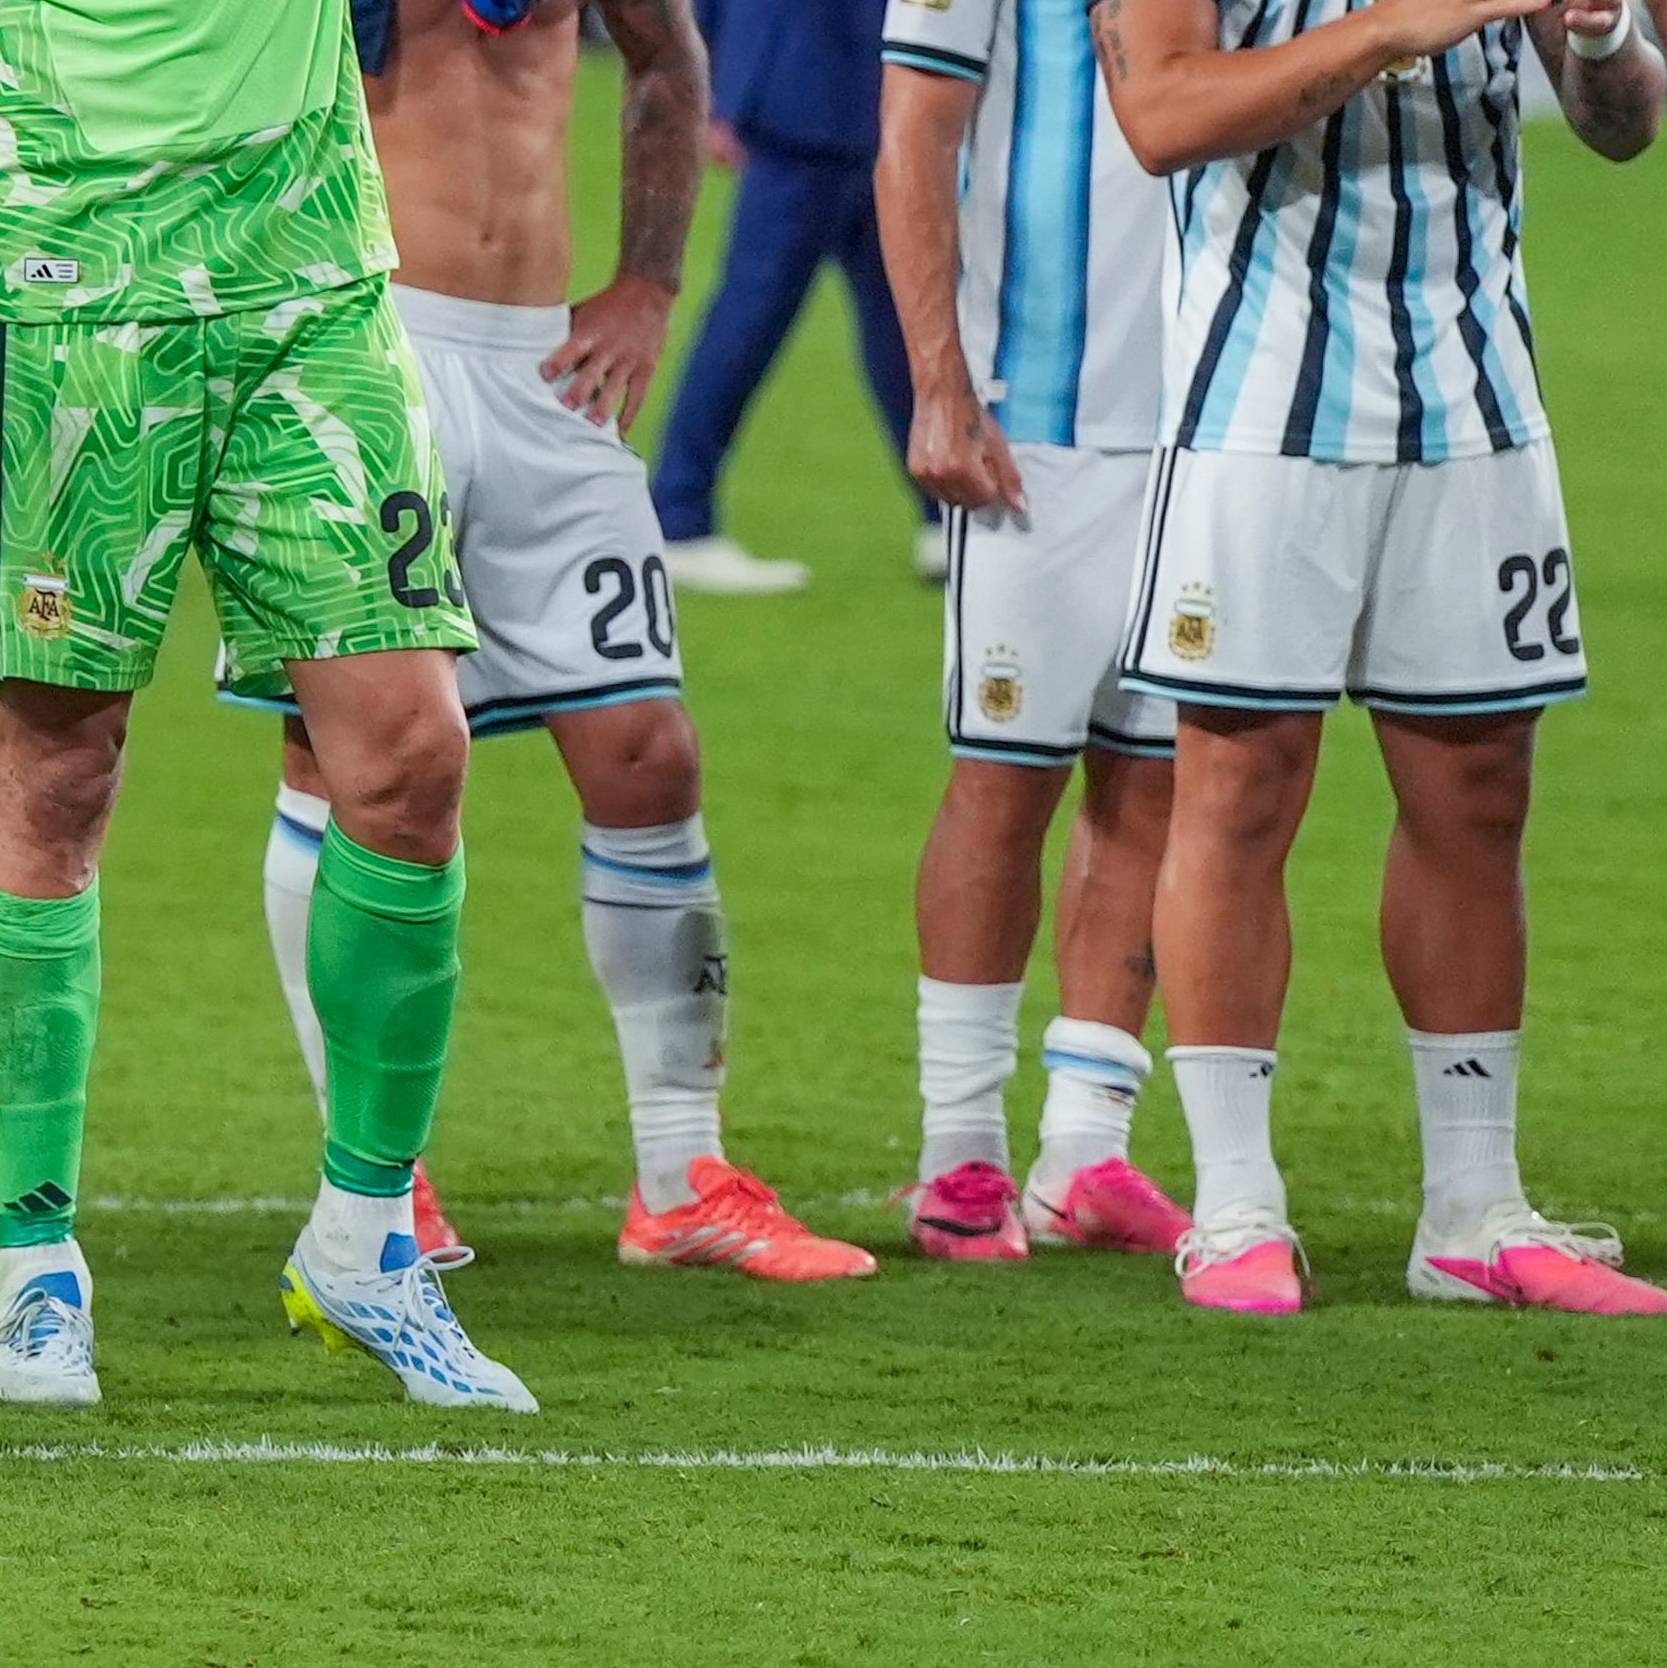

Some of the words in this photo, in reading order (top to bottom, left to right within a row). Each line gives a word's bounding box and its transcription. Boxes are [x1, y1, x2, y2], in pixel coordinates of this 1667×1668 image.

[29, 587, 59, 622] AFA
[584, 556, 674, 660] 20
[1498, 548, 1579, 661] 22
